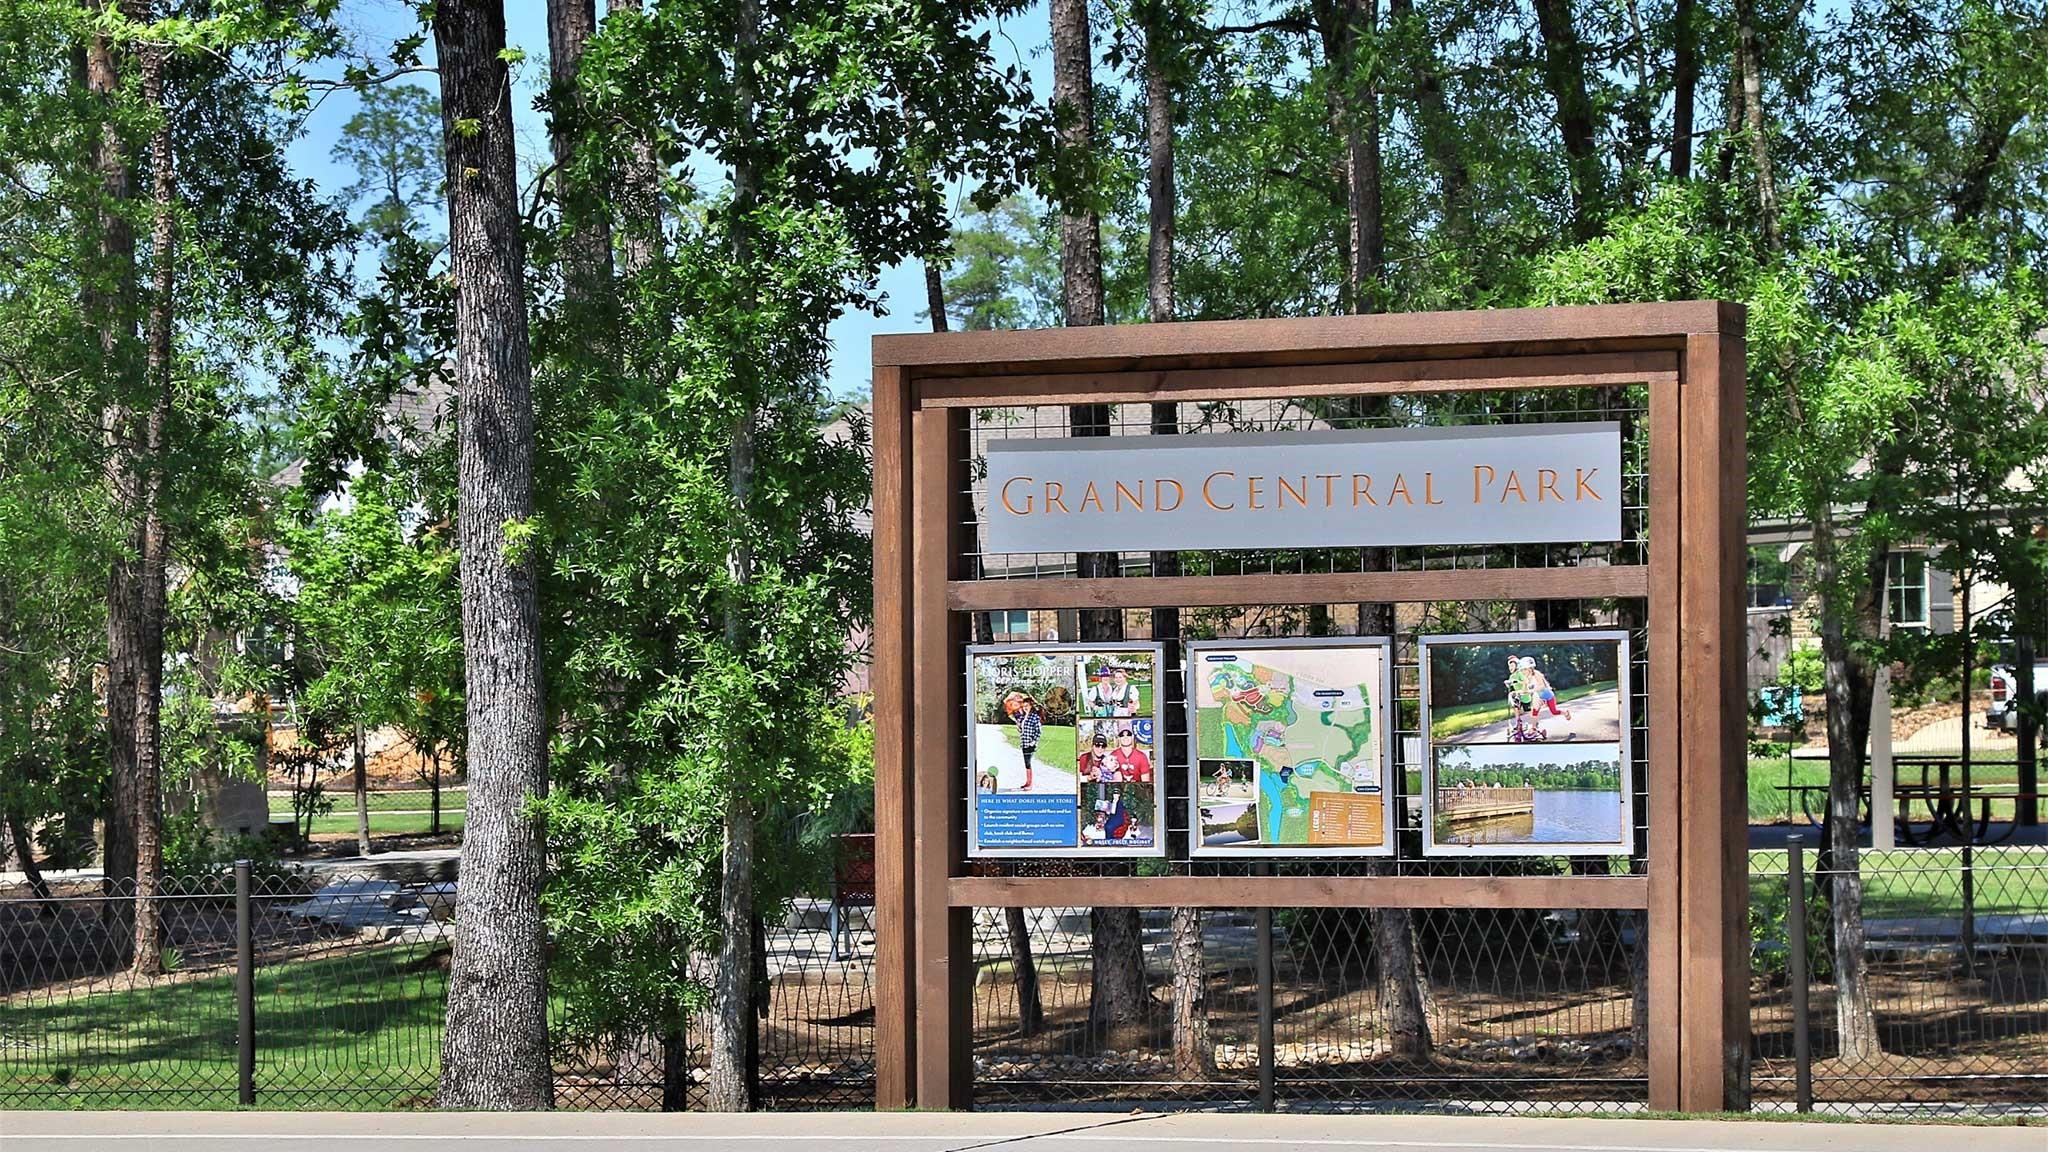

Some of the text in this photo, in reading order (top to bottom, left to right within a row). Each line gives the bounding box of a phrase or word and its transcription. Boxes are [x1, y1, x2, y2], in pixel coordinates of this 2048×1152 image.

[1000, 463, 1603, 516] GRAND CENTRAL PARK
[983, 666, 1071, 677] DORIS HOPPER
